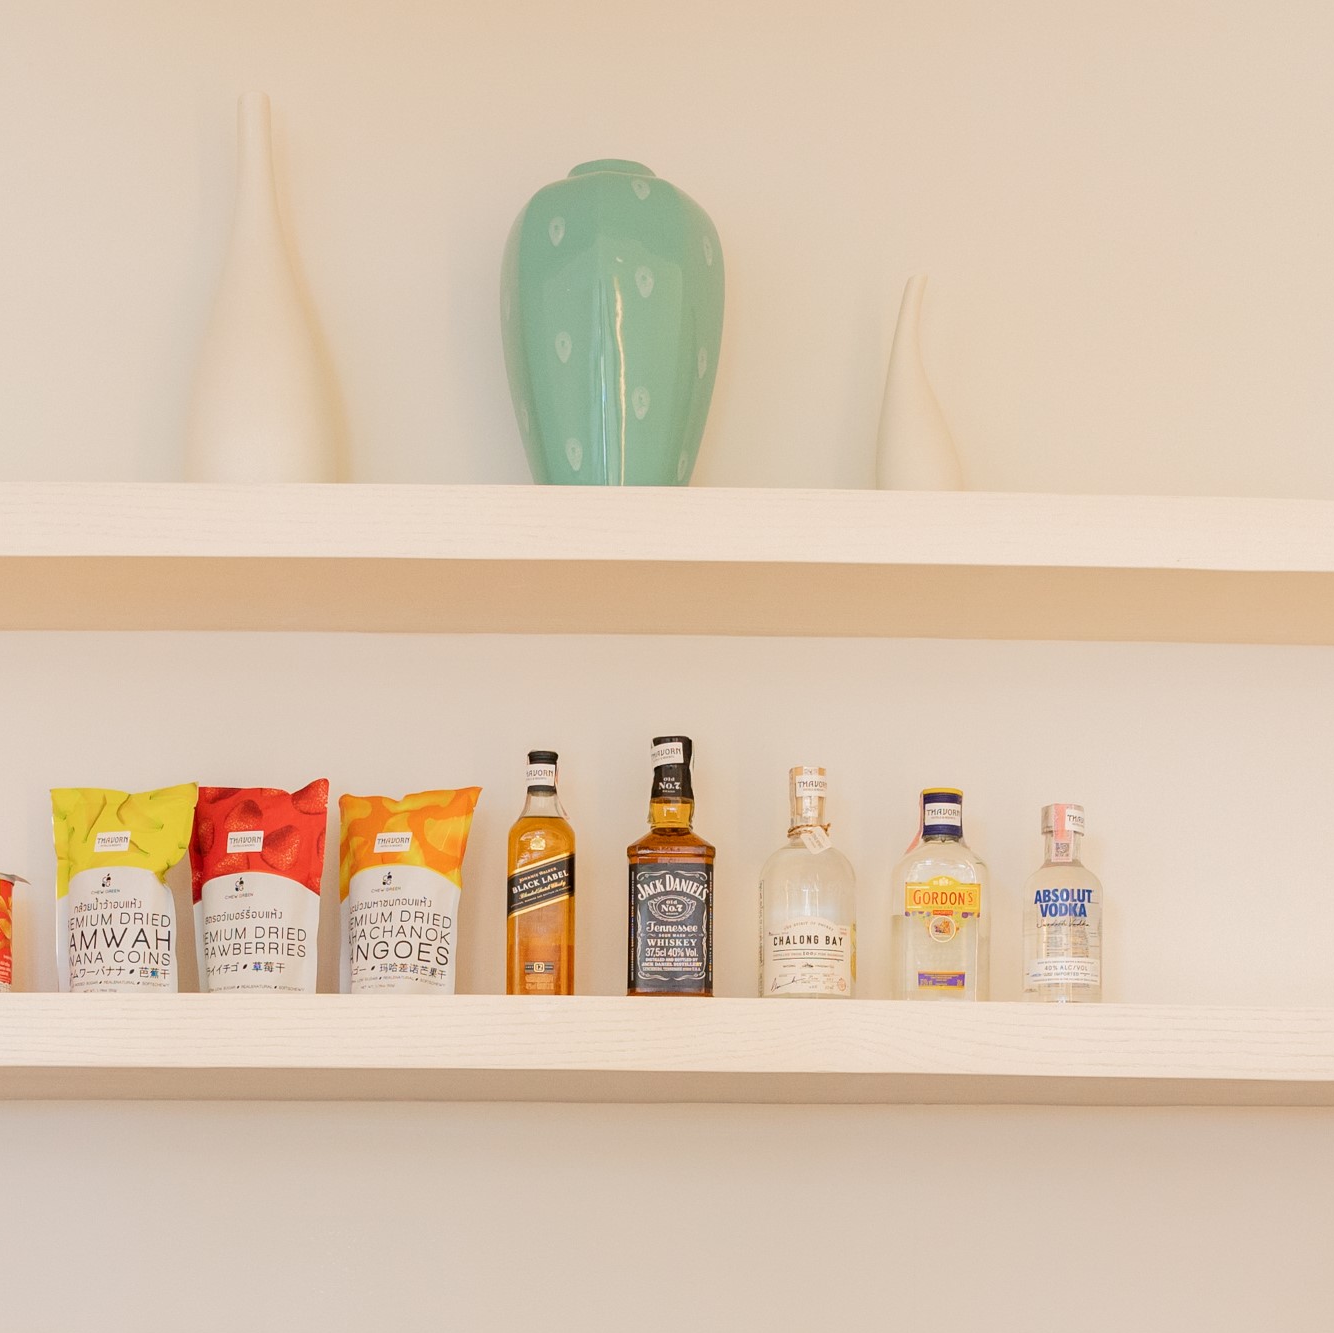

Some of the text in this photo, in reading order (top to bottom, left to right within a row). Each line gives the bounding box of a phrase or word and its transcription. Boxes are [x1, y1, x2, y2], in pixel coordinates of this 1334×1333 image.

[658, 782, 681, 790] No.7
[97, 836, 128, 845] THAVORN
[229, 836, 262, 845] THAVORN
[377, 837, 410, 845] THAVORN
[512, 870, 569, 894] BLACK LABEL
[637, 878, 665, 901] JACK
[1034, 888, 1093, 904] ABSOLUT
[913, 889, 974, 906] GORDON'S
[661, 904, 683, 913] No.7
[1039, 903, 1088, 918] VODKA
[119, 912, 171, 928] DRIED
[399, 910, 452, 929] DRIED
[254, 925, 307, 942] DRIED
[646, 921, 698, 933] Tennessee
[647, 938, 698, 947] WHISKEY
[773, 934, 843, 946] CHALONG BAY
[113, 950, 171, 967] COINS
[667, 947, 684, 957] 40%
[685, 947, 698, 957] Vol.
